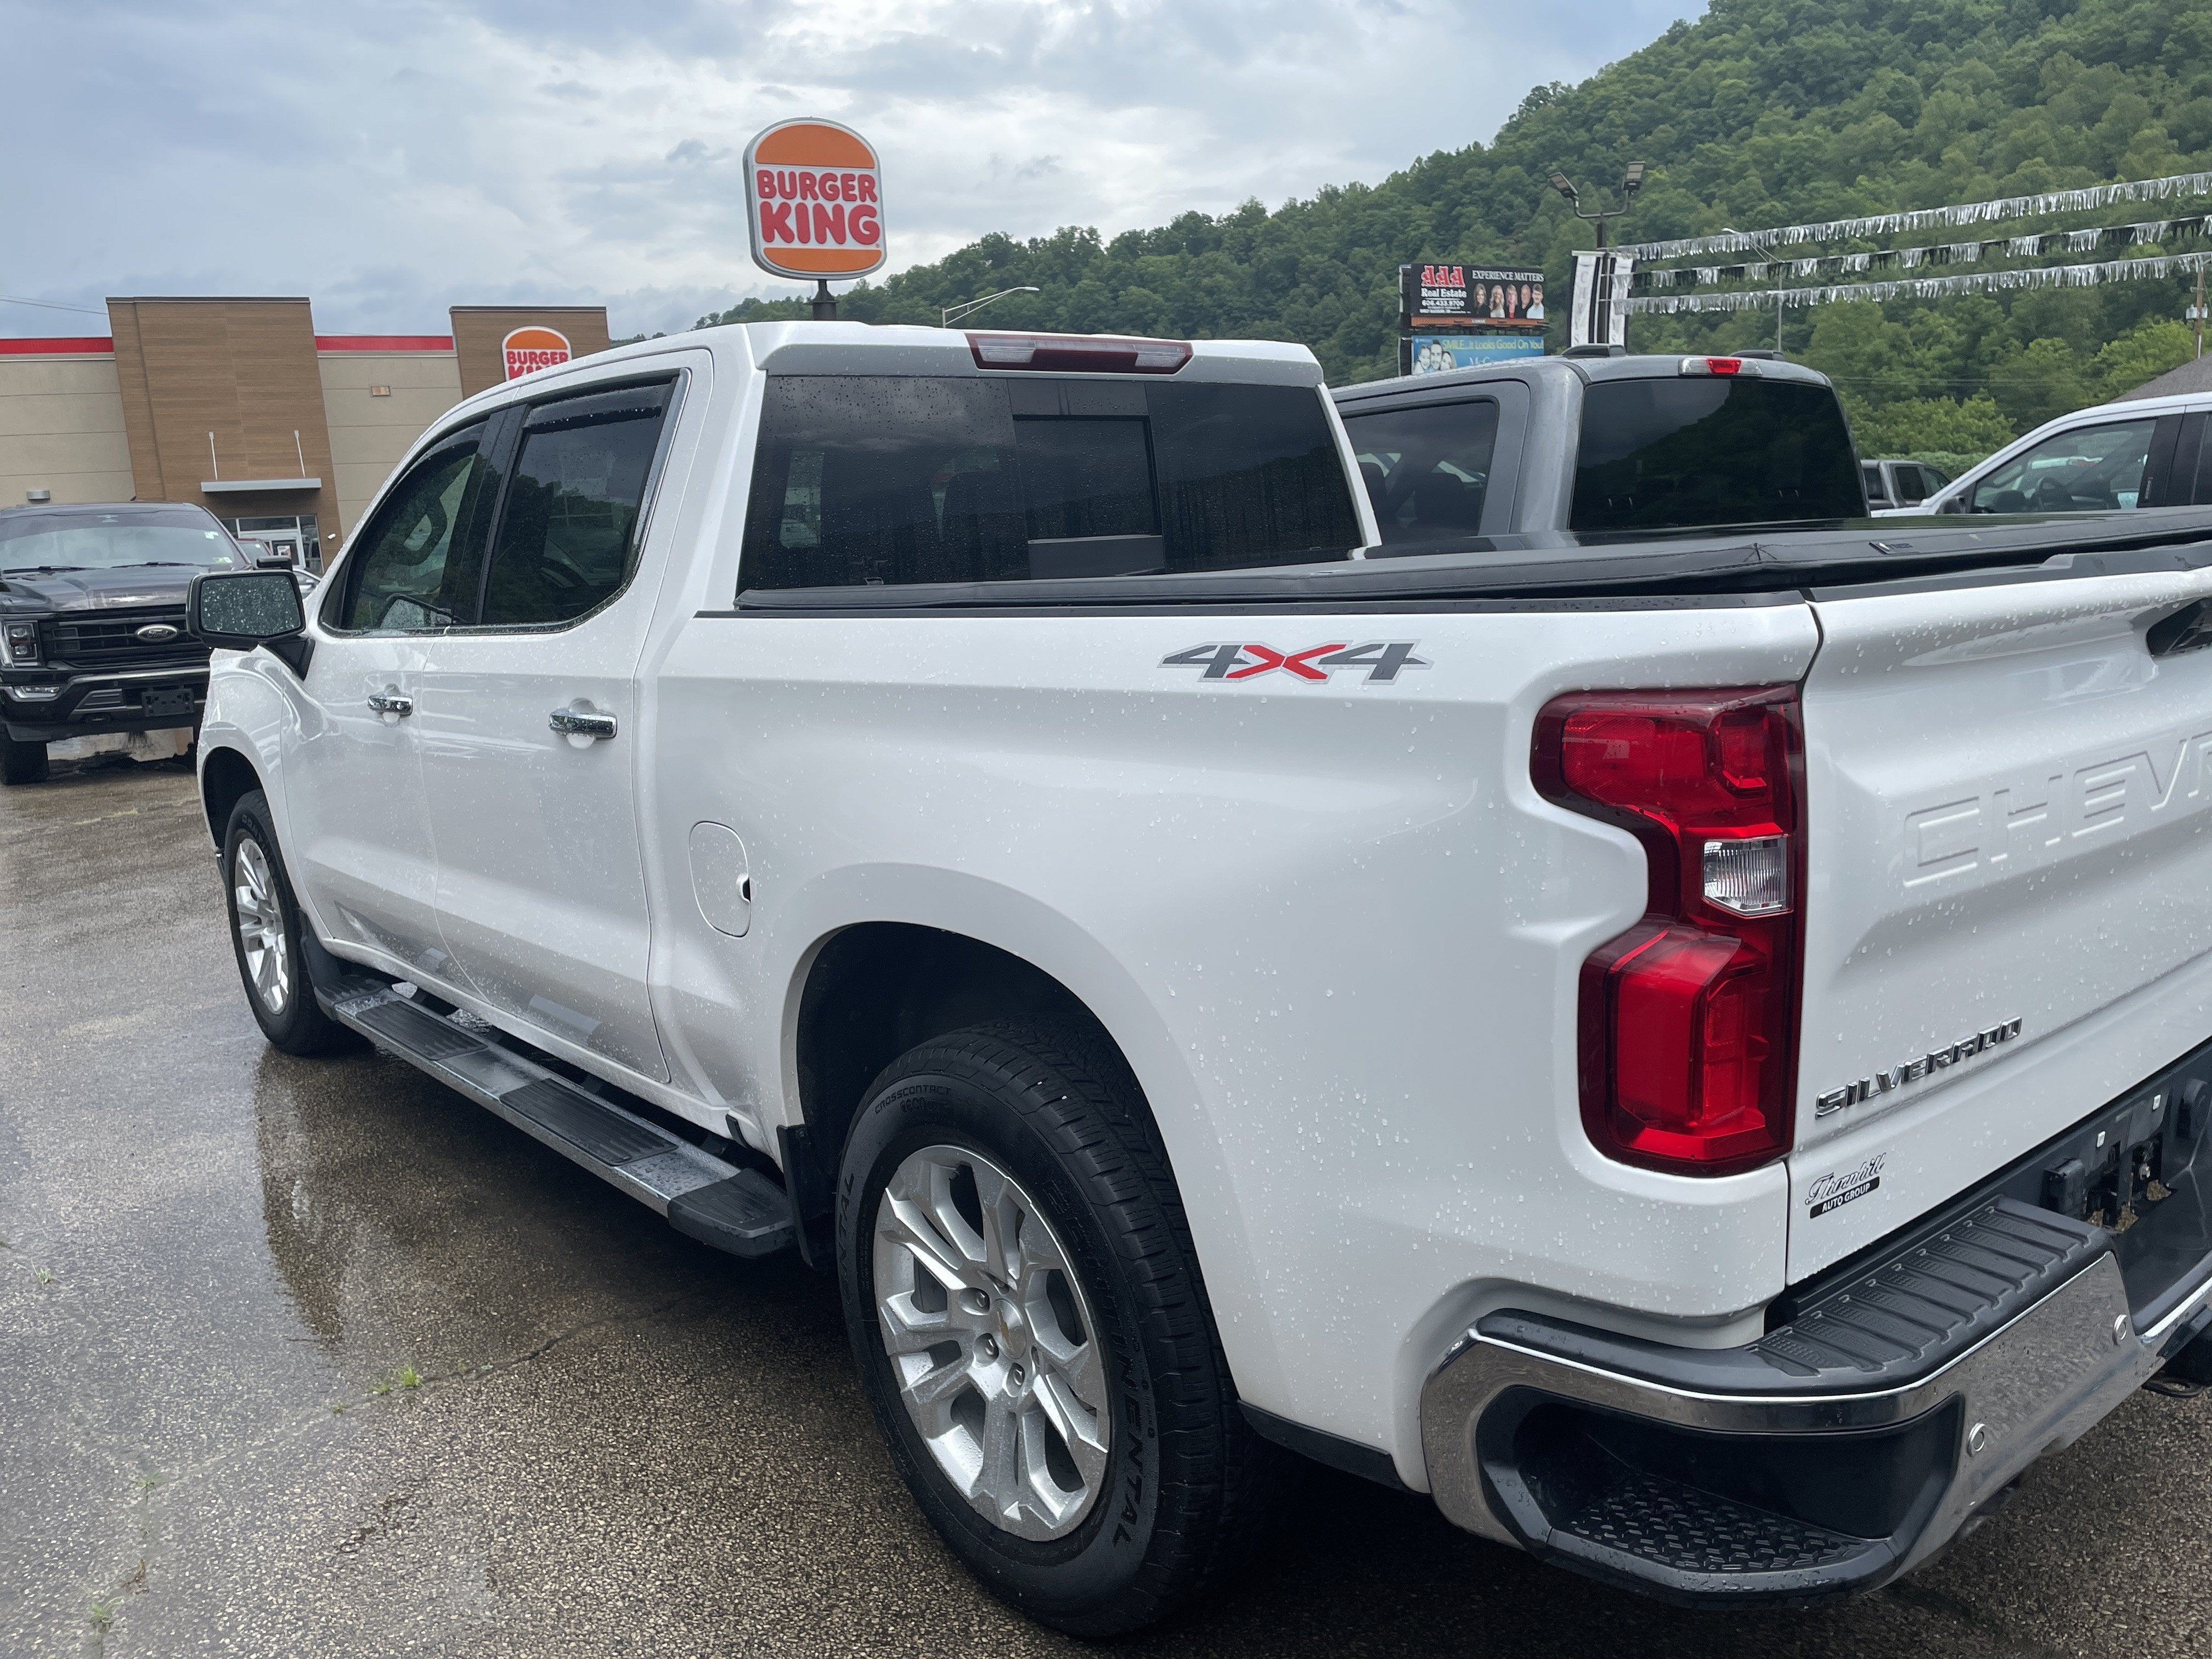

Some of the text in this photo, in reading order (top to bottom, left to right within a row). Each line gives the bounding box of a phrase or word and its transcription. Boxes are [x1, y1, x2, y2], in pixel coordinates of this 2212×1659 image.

[757, 170, 877, 202] BURGER
[760, 201, 880, 245] KING
[1472, 270, 1544, 282] EXPERIENCE MATTERS
[1421, 288, 1467, 298] Real Estate
[506, 351, 569, 365] BURGER
[1497, 339, 1516, 349] Good
[1517, 339, 1528, 349] On
[147, 629, 168, 638] Ford
[1815, 1016, 2022, 1120] SILVERADO
[874, 1084, 952, 1115] CROSSCONTACT
[1805, 1152, 1887, 1205] Thornhill
[1822, 1182, 1871, 1213] AUTO GROUP
